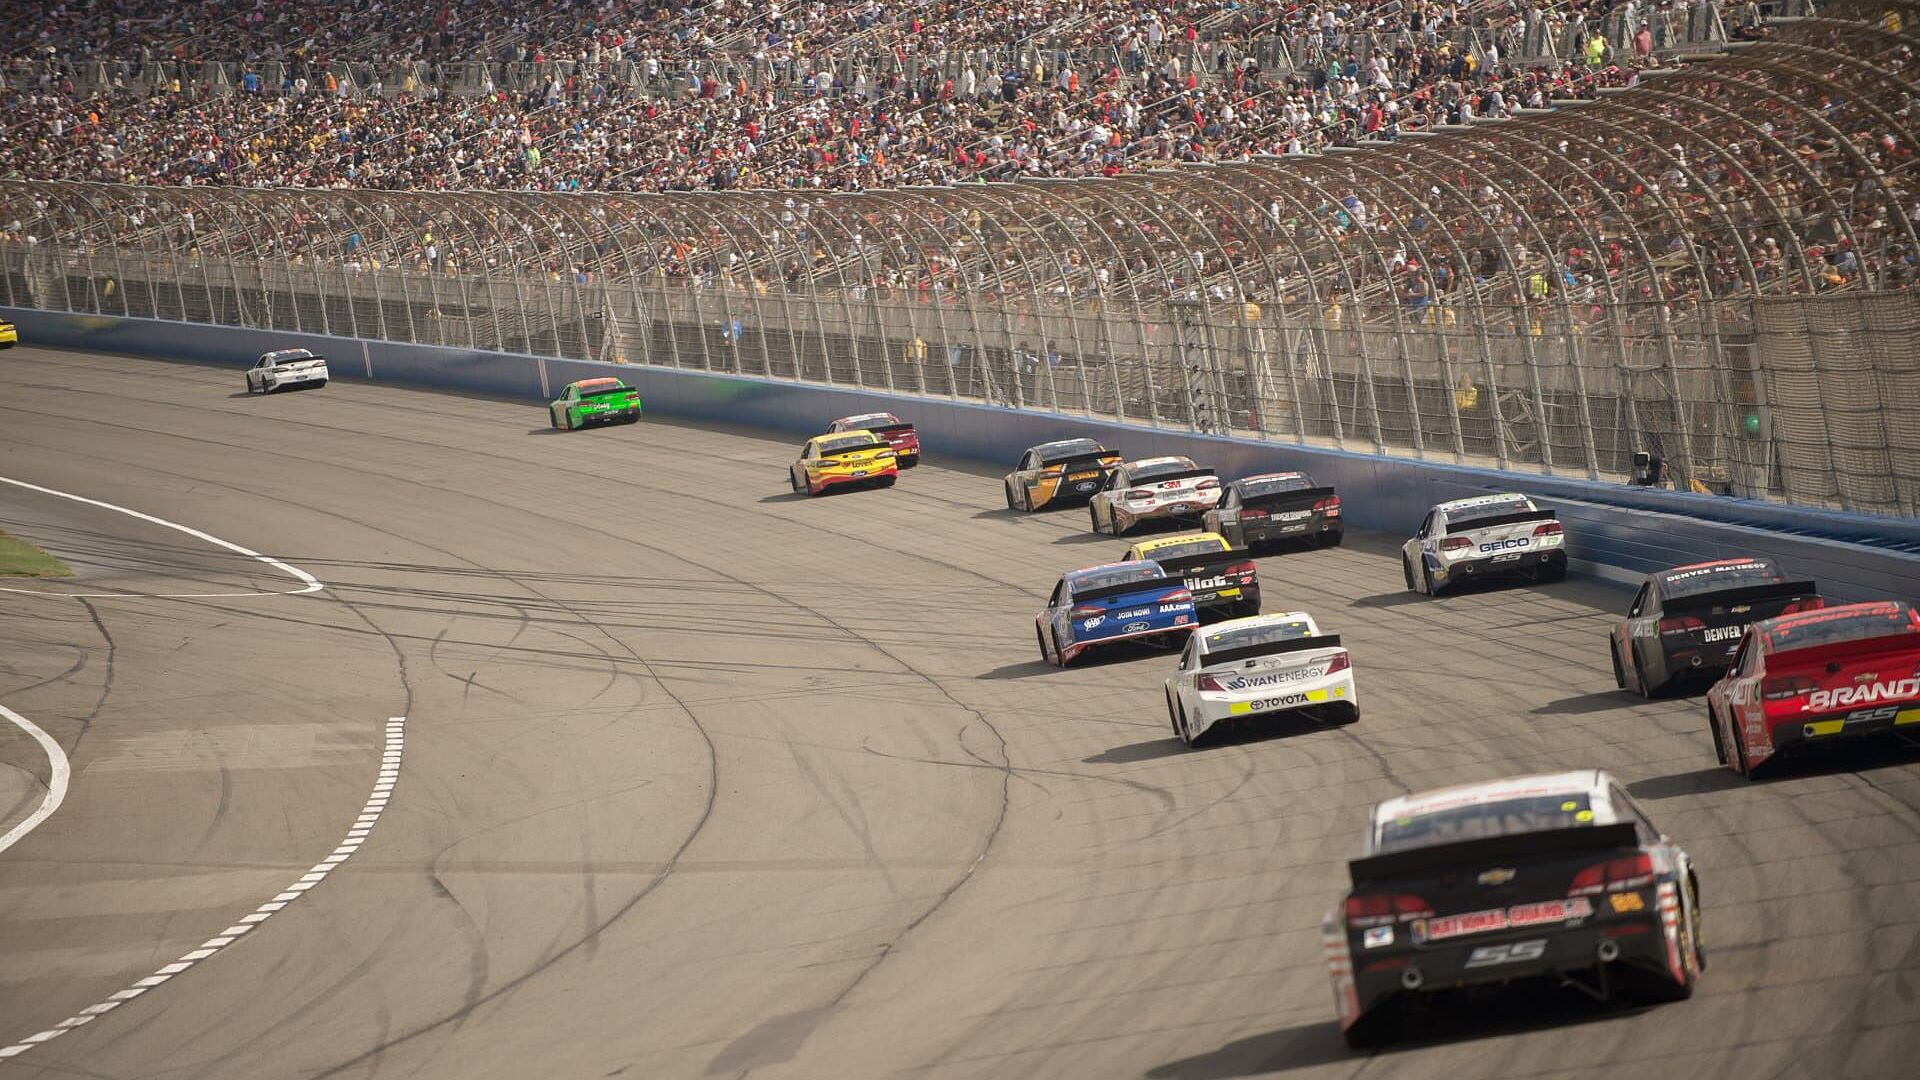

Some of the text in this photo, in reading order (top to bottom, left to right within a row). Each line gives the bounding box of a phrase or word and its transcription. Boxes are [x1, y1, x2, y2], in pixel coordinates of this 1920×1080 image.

[1480, 538, 1530, 553] GEICO
[1666, 563, 1768, 582] DENVER MATTRESS
[1184, 575, 1226, 591] ilot
[1160, 602, 1190, 612] AAA.com
[1124, 622, 1149, 633] Ford
[1704, 625, 1742, 643] DENVER
[1264, 693, 1309, 708] TOYOTA
[1845, 706, 1899, 725] SS
[1464, 939, 1548, 969] SS
